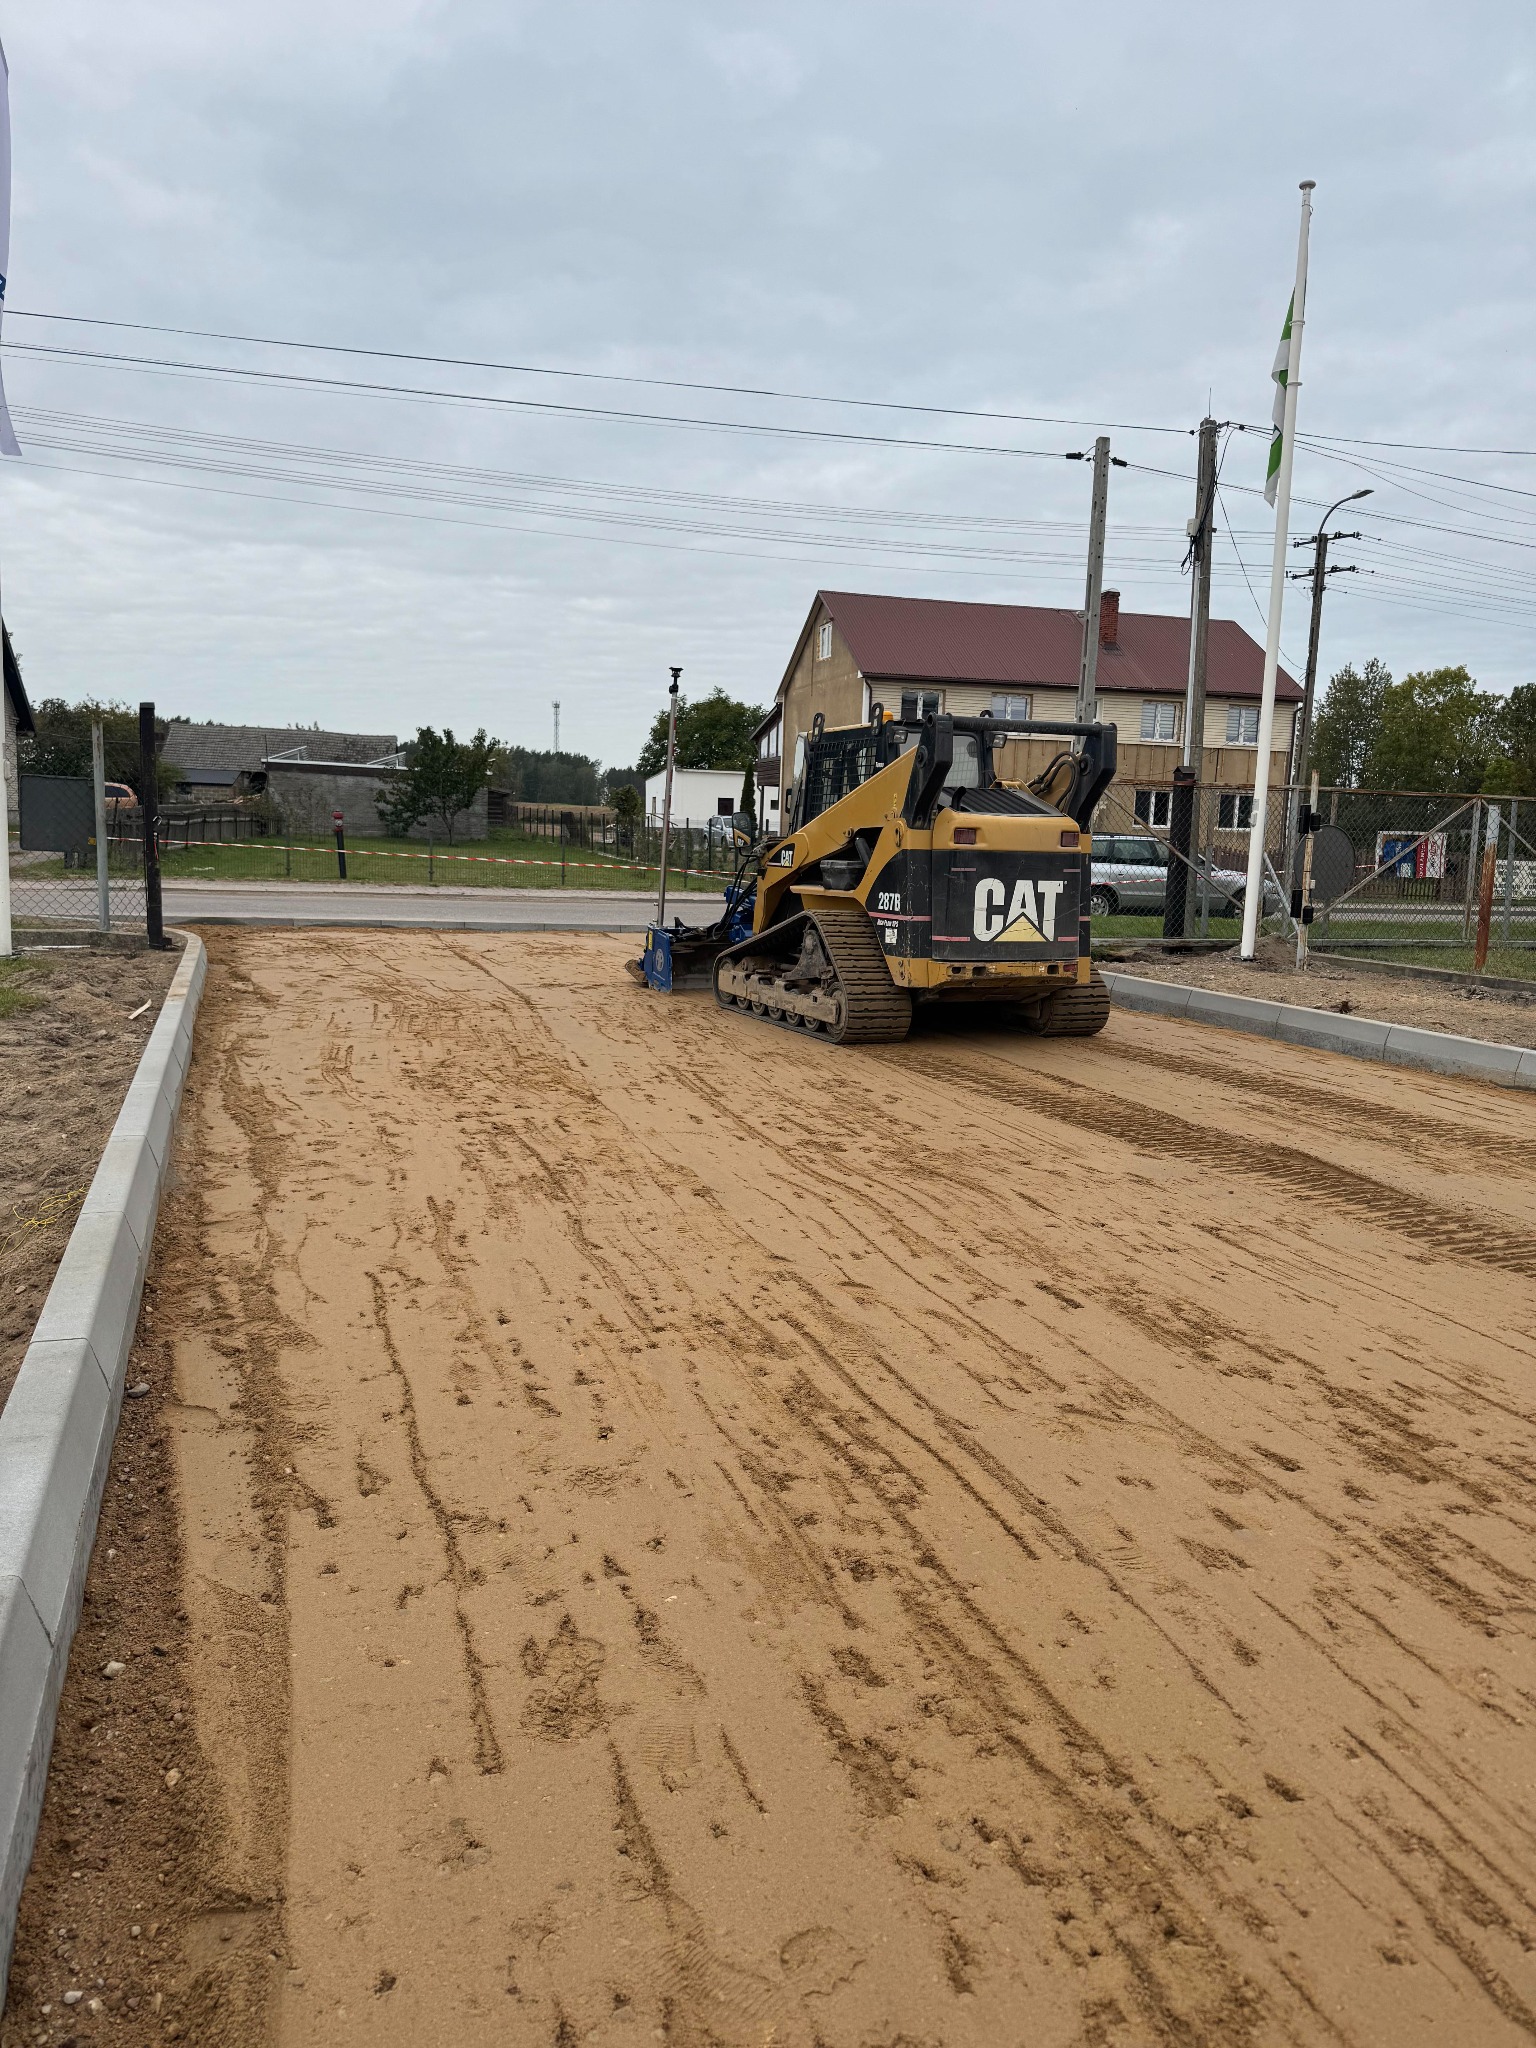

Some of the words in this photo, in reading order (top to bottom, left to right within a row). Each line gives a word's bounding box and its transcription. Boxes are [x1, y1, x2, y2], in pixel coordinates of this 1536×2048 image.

[781, 850, 793, 866] CAT
[878, 892, 900, 911] 287B
[974, 878, 1064, 942] CAT
